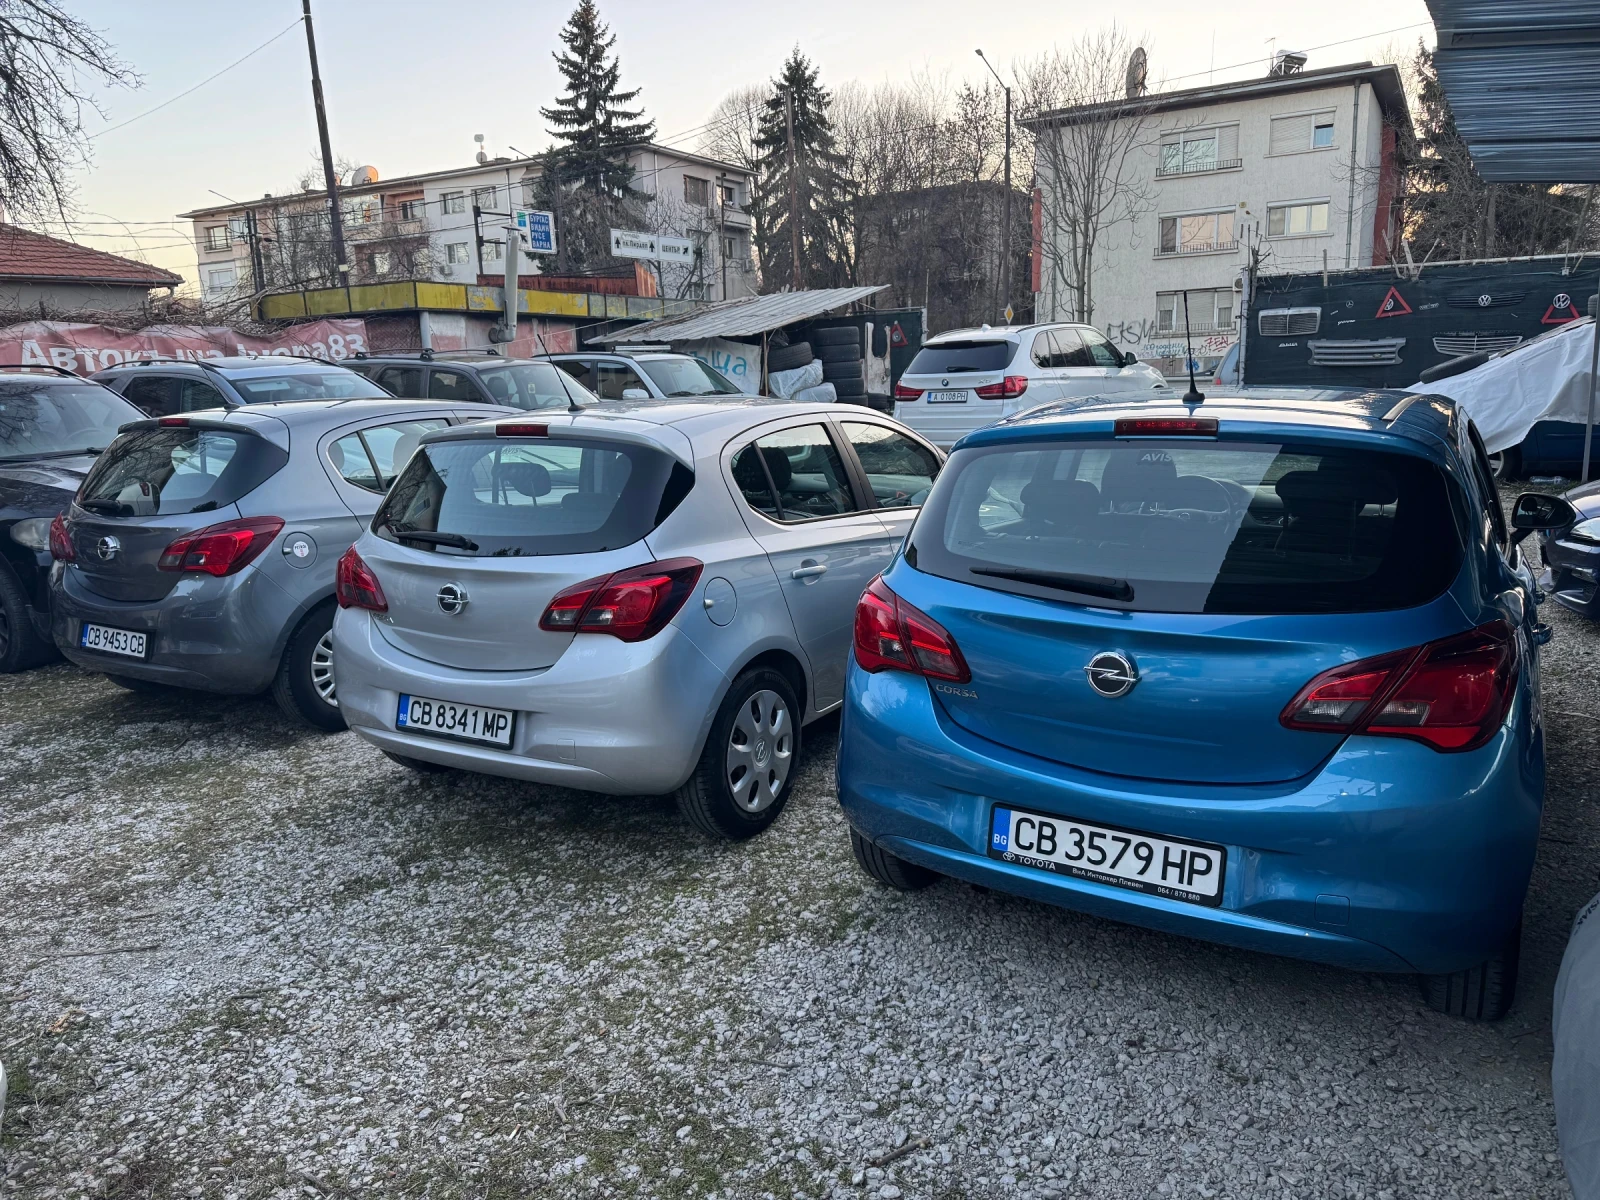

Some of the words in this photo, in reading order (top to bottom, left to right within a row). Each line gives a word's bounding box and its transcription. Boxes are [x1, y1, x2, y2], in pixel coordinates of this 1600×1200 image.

[530, 215, 549, 223] БУРГАС
[531, 223, 550, 231] ВИДИН
[532, 231, 546, 239] РУСЕ
[532, 240, 551, 249] ВАРНА
[662, 244, 680, 254] ЦЕНТЪР
[941, 392, 956, 400] 0108
[1141, 453, 1173, 462] AVIS
[88, 627, 101, 646] CB
[103, 630, 128, 650] 9453
[130, 635, 144, 654] CB
[935, 684, 979, 700] CORSA
[409, 700, 432, 726] CB
[435, 704, 479, 734] 8341
[482, 711, 508, 738] MP
[993, 833, 1007, 845] BG
[1014, 817, 1058, 856] CB
[1065, 827, 1154, 876] 3579
[1161, 846, 1213, 886] HP
[1018, 855, 1056, 870] TOYOTA
[1157, 886, 1169, 895] 064
[1174, 890, 1187, 898] 870
